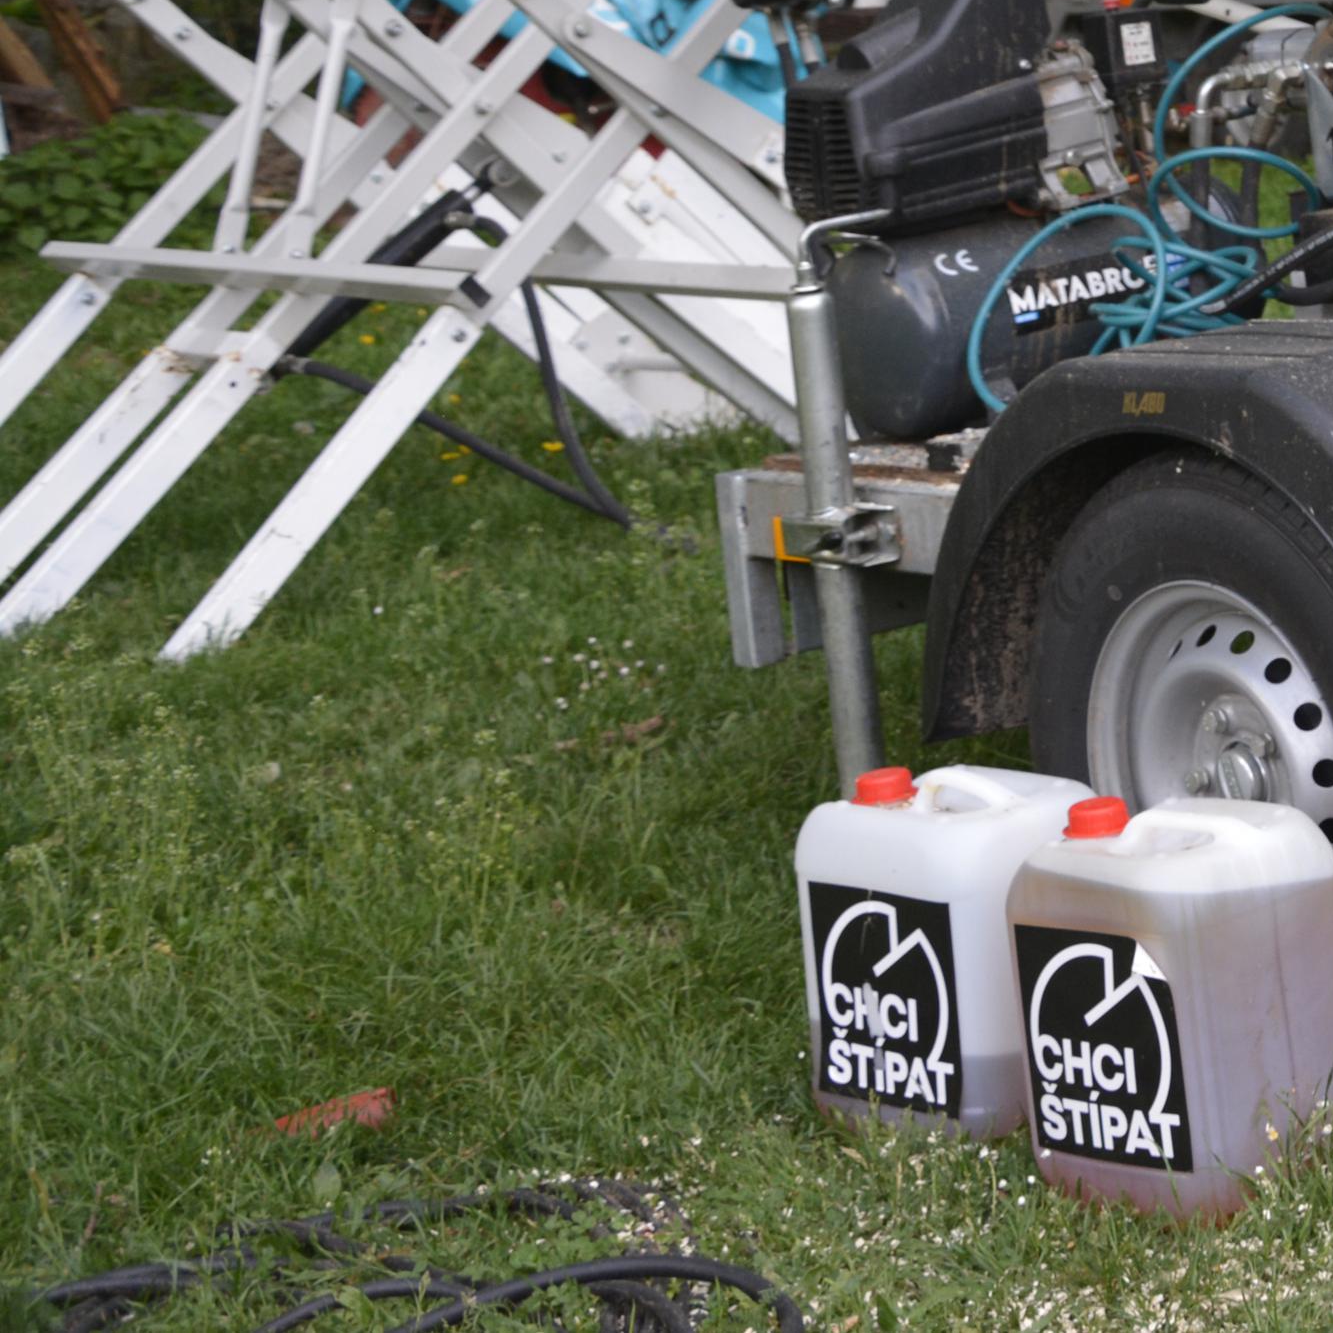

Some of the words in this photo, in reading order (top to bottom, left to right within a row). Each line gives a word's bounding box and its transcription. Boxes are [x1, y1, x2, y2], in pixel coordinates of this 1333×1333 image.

[827, 981, 919, 1043] CHCI
[827, 1026, 955, 1106] ŠTÍPAT
[1033, 1033, 1138, 1095] CHCI
[1040, 1080, 1181, 1159] ŠTÍPAT
